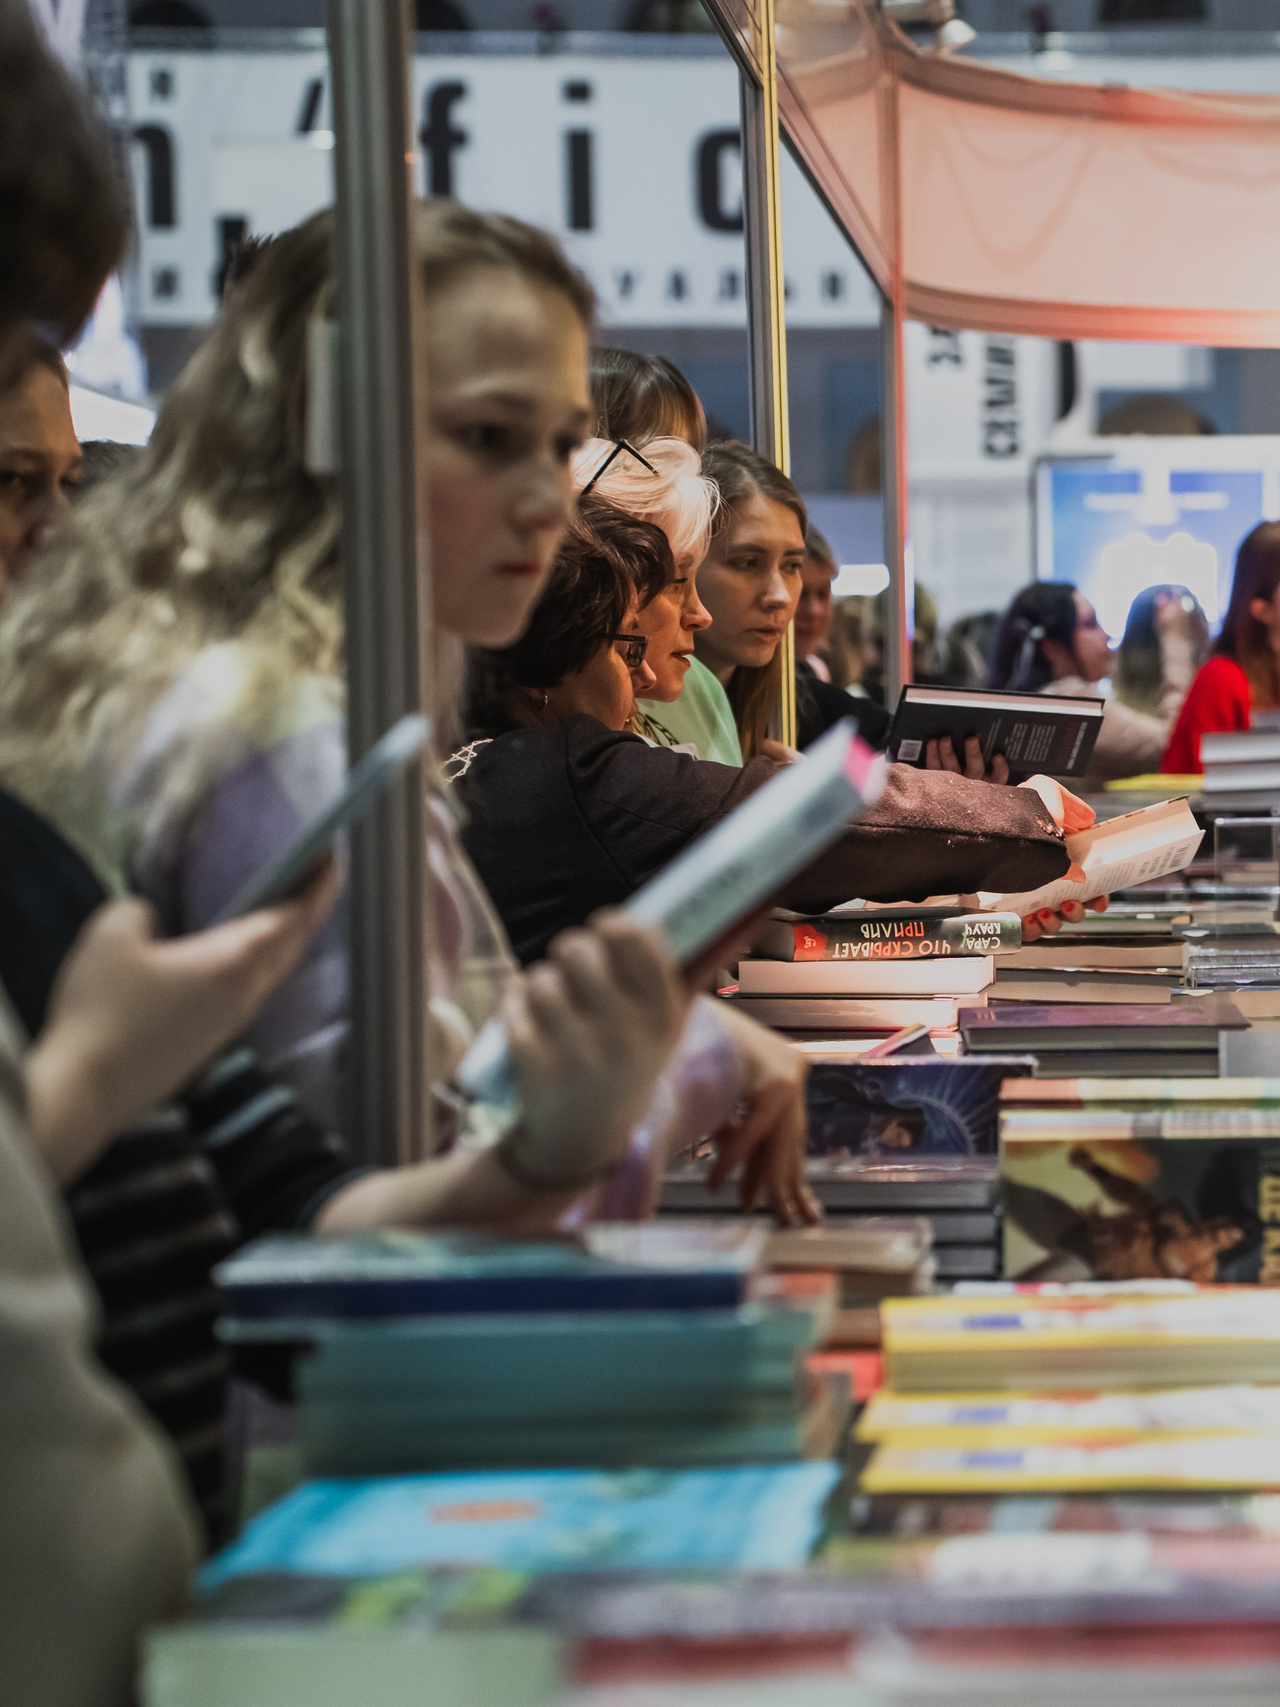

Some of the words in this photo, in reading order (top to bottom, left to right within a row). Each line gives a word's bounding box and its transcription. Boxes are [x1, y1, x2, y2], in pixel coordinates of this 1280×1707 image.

[860, 921, 924, 939] ПРИЛИВ
[964, 922, 1001, 936] КРАУЧ
[832, 940, 914, 958] СКРЫВАЕТ
[918, 939, 951, 955] ЧТО
[966, 936, 1001, 950] САРА
